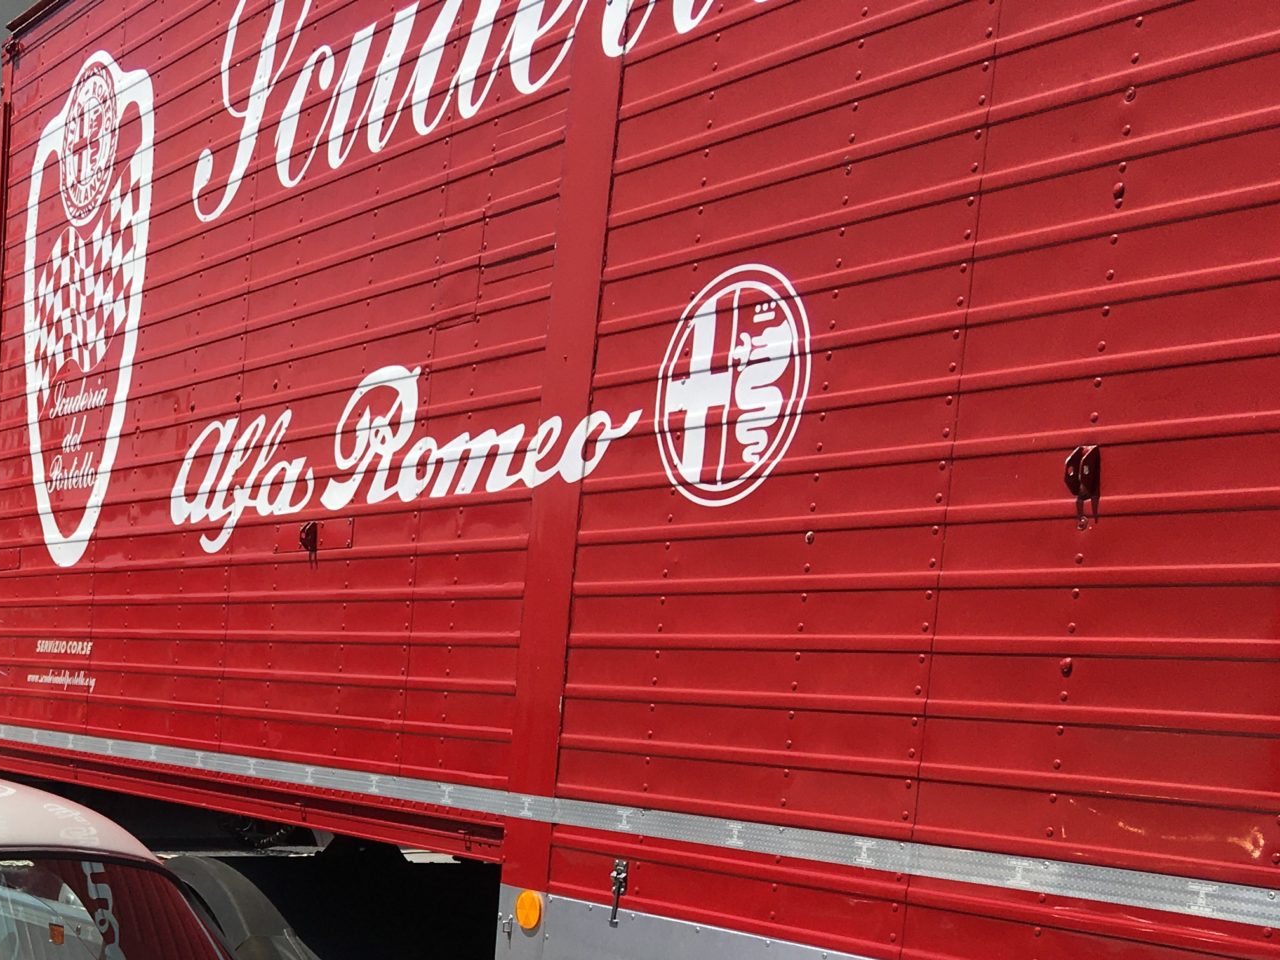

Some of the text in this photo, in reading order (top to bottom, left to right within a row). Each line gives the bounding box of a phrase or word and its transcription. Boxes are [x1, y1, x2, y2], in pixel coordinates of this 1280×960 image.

[91, 80, 112, 133] ROMEO
[70, 168, 103, 205] MILANO
[48, 377, 108, 419] Scuderia
[61, 415, 87, 453] del
[47, 452, 99, 494] Portello
[170, 365, 643, 554] Alfa Romeo
[36, 640, 93, 655] SERVIZIO CORSE
